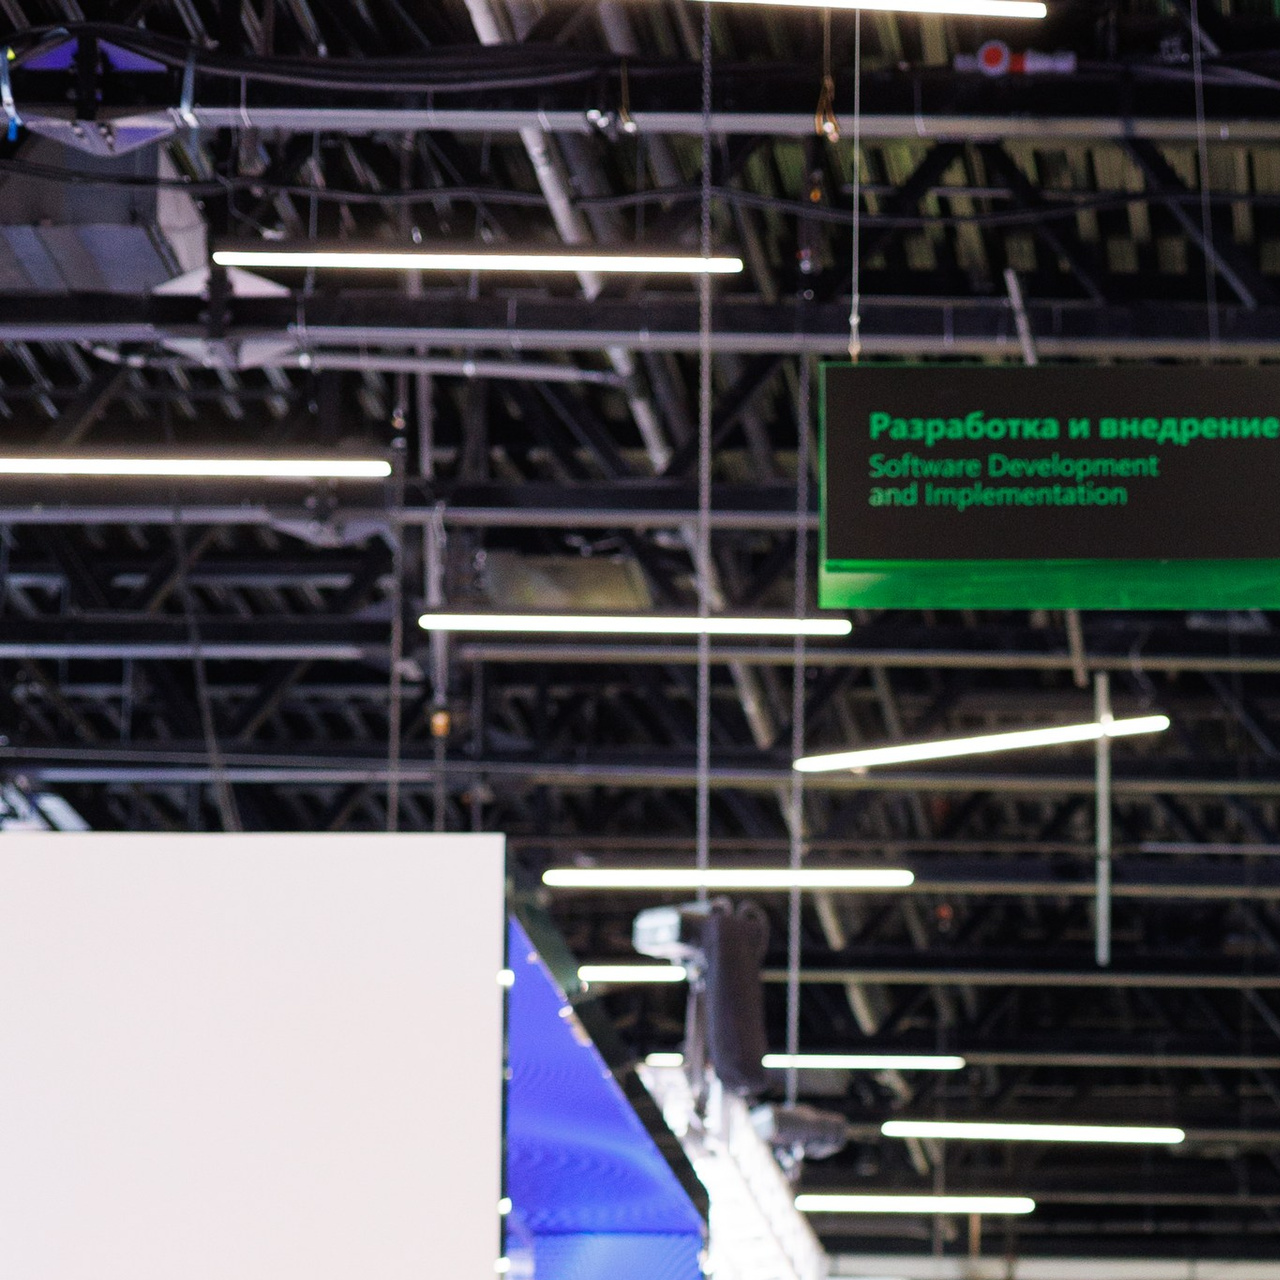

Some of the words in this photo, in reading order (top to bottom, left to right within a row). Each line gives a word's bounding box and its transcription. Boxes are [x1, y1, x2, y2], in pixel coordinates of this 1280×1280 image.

[868, 410, 1060, 446] Разработка
[1068, 416, 1091, 440] и
[1100, 414, 1280, 446] внедрение
[868, 453, 981, 479] Software
[988, 453, 1160, 482] Development
[868, 482, 918, 507] and
[925, 482, 1128, 512] Implementation
